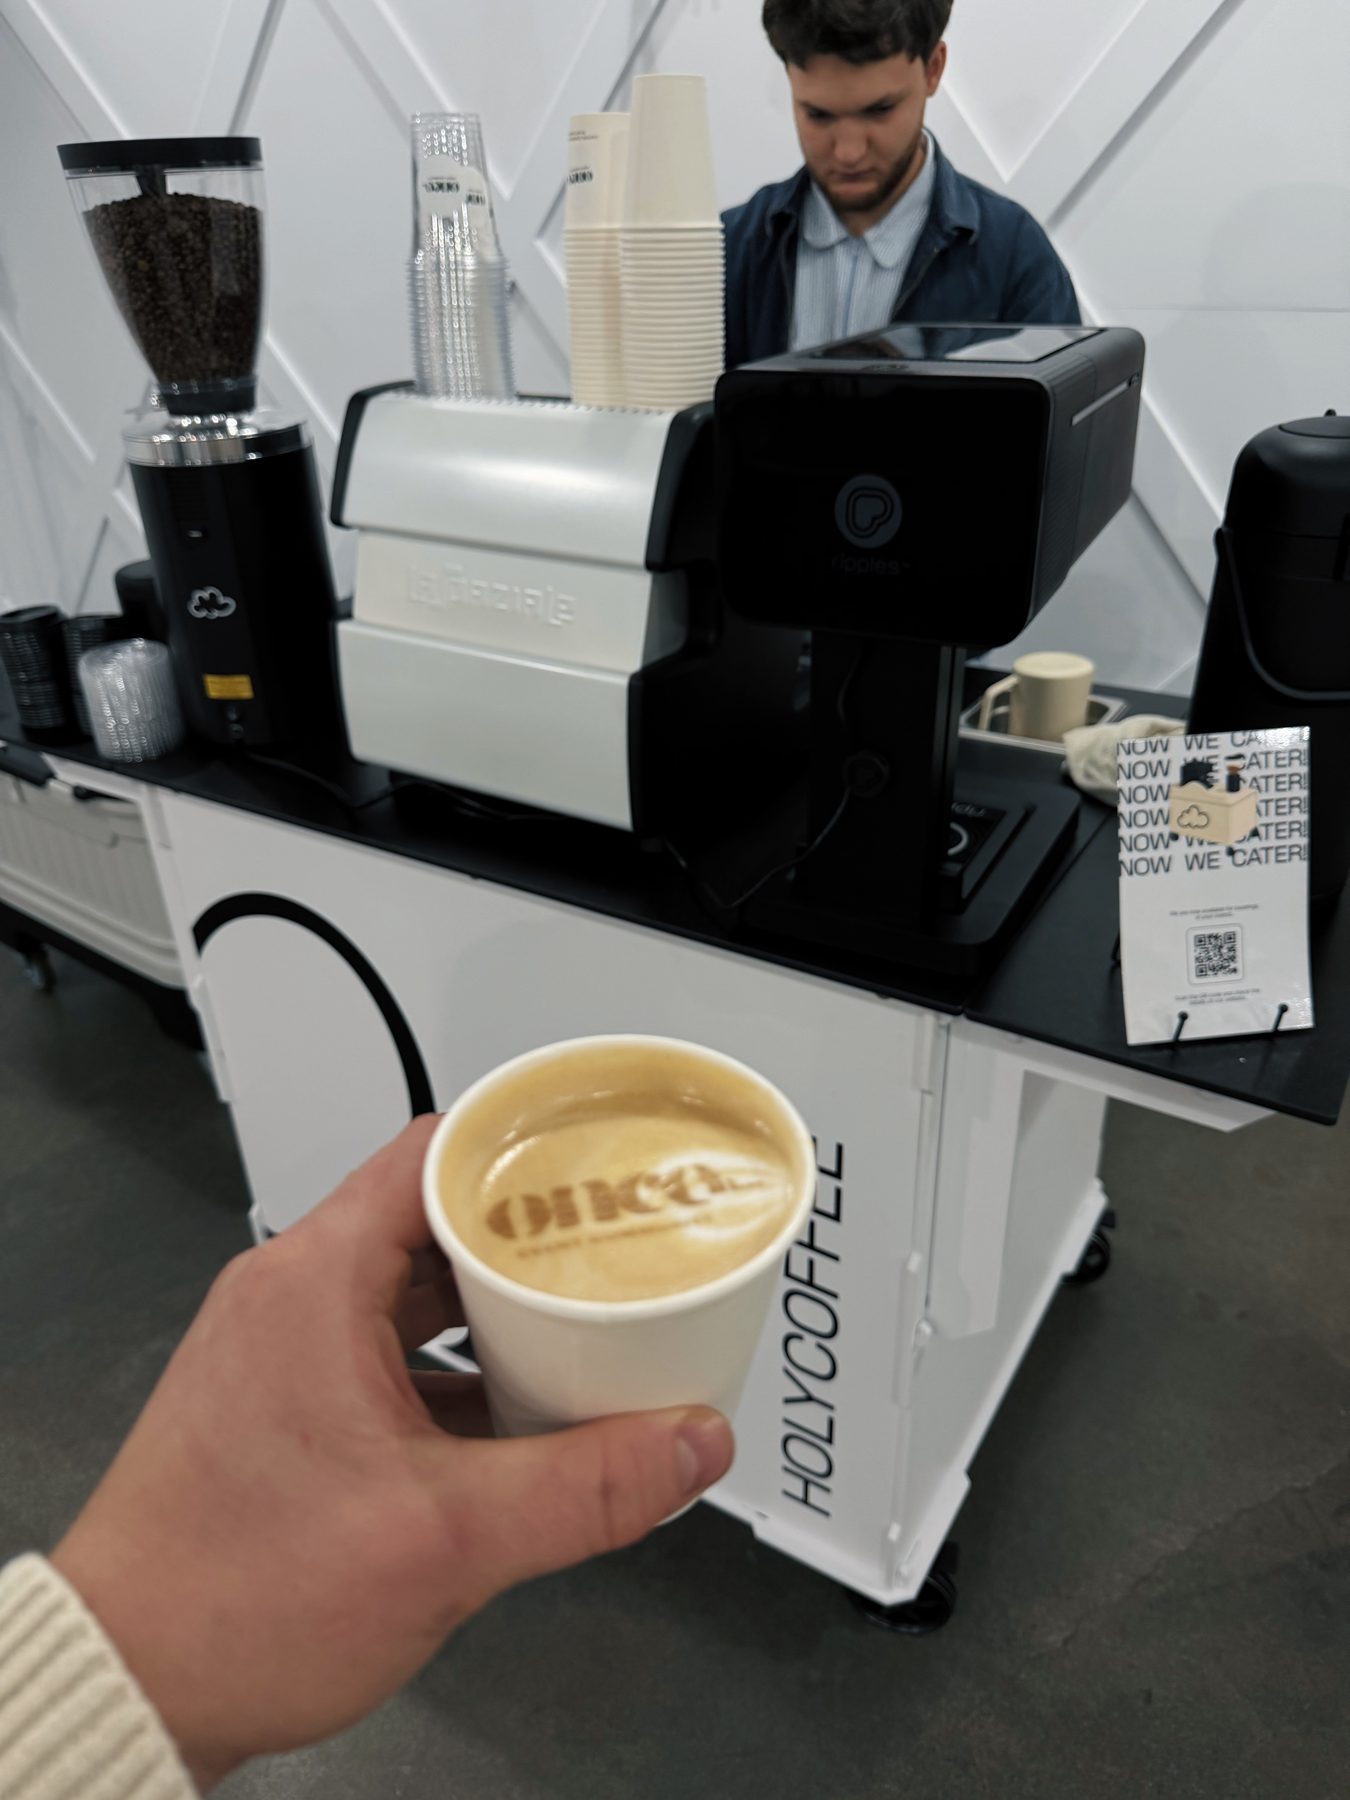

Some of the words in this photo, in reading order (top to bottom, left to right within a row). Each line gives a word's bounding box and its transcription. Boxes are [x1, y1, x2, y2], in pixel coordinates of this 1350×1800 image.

[1117, 738, 1169, 756] NOW
[1185, 734, 1219, 750] WE
[1118, 758, 1170, 780] NOW
[1118, 784, 1170, 804] NOW
[1119, 808, 1170, 829] NOW
[1119, 832, 1171, 852] NOW
[1120, 855, 1172, 877] NOW
[1185, 851, 1220, 872] WE
